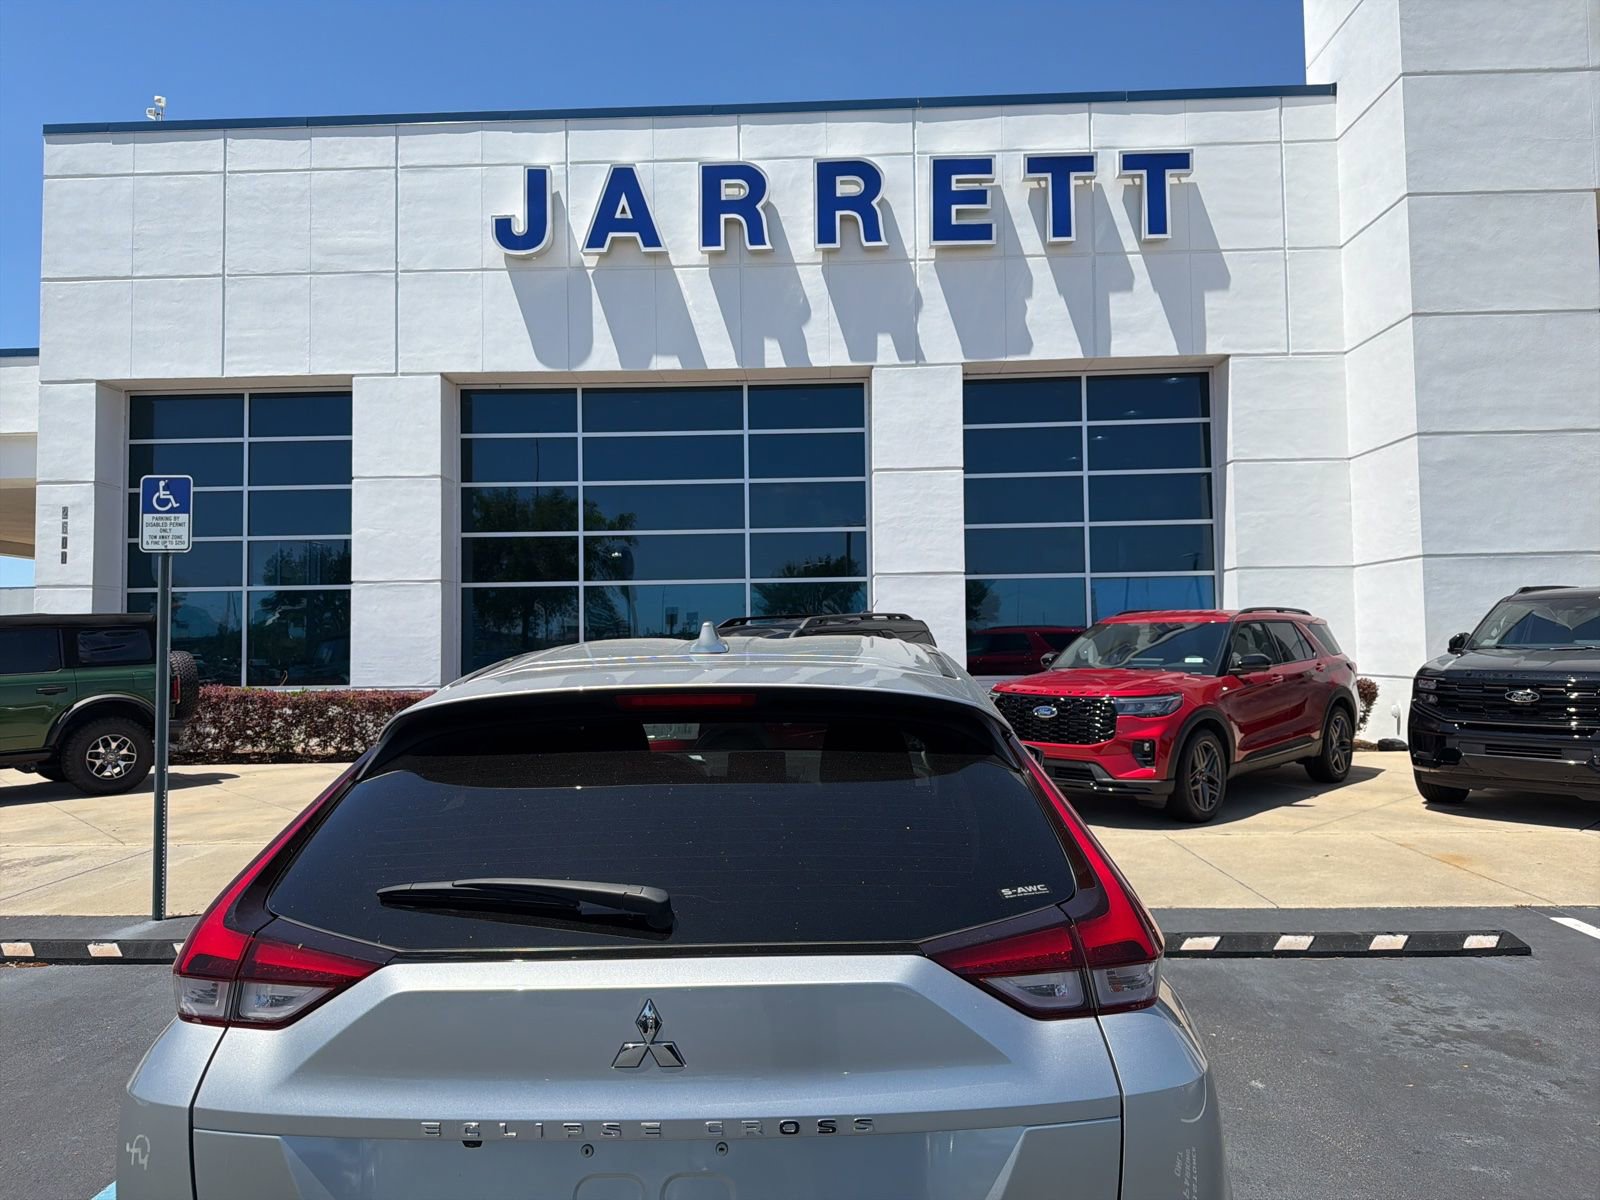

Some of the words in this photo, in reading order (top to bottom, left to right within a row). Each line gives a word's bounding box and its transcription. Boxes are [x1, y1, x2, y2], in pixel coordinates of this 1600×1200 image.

[491, 149, 1195, 257] JARRETT
[1510, 691, 1535, 701] Ford
[1001, 884, 1048, 895] S-AWC
[420, 1121, 661, 1138] ECLIPSE
[705, 1116, 875, 1136] CROSS
